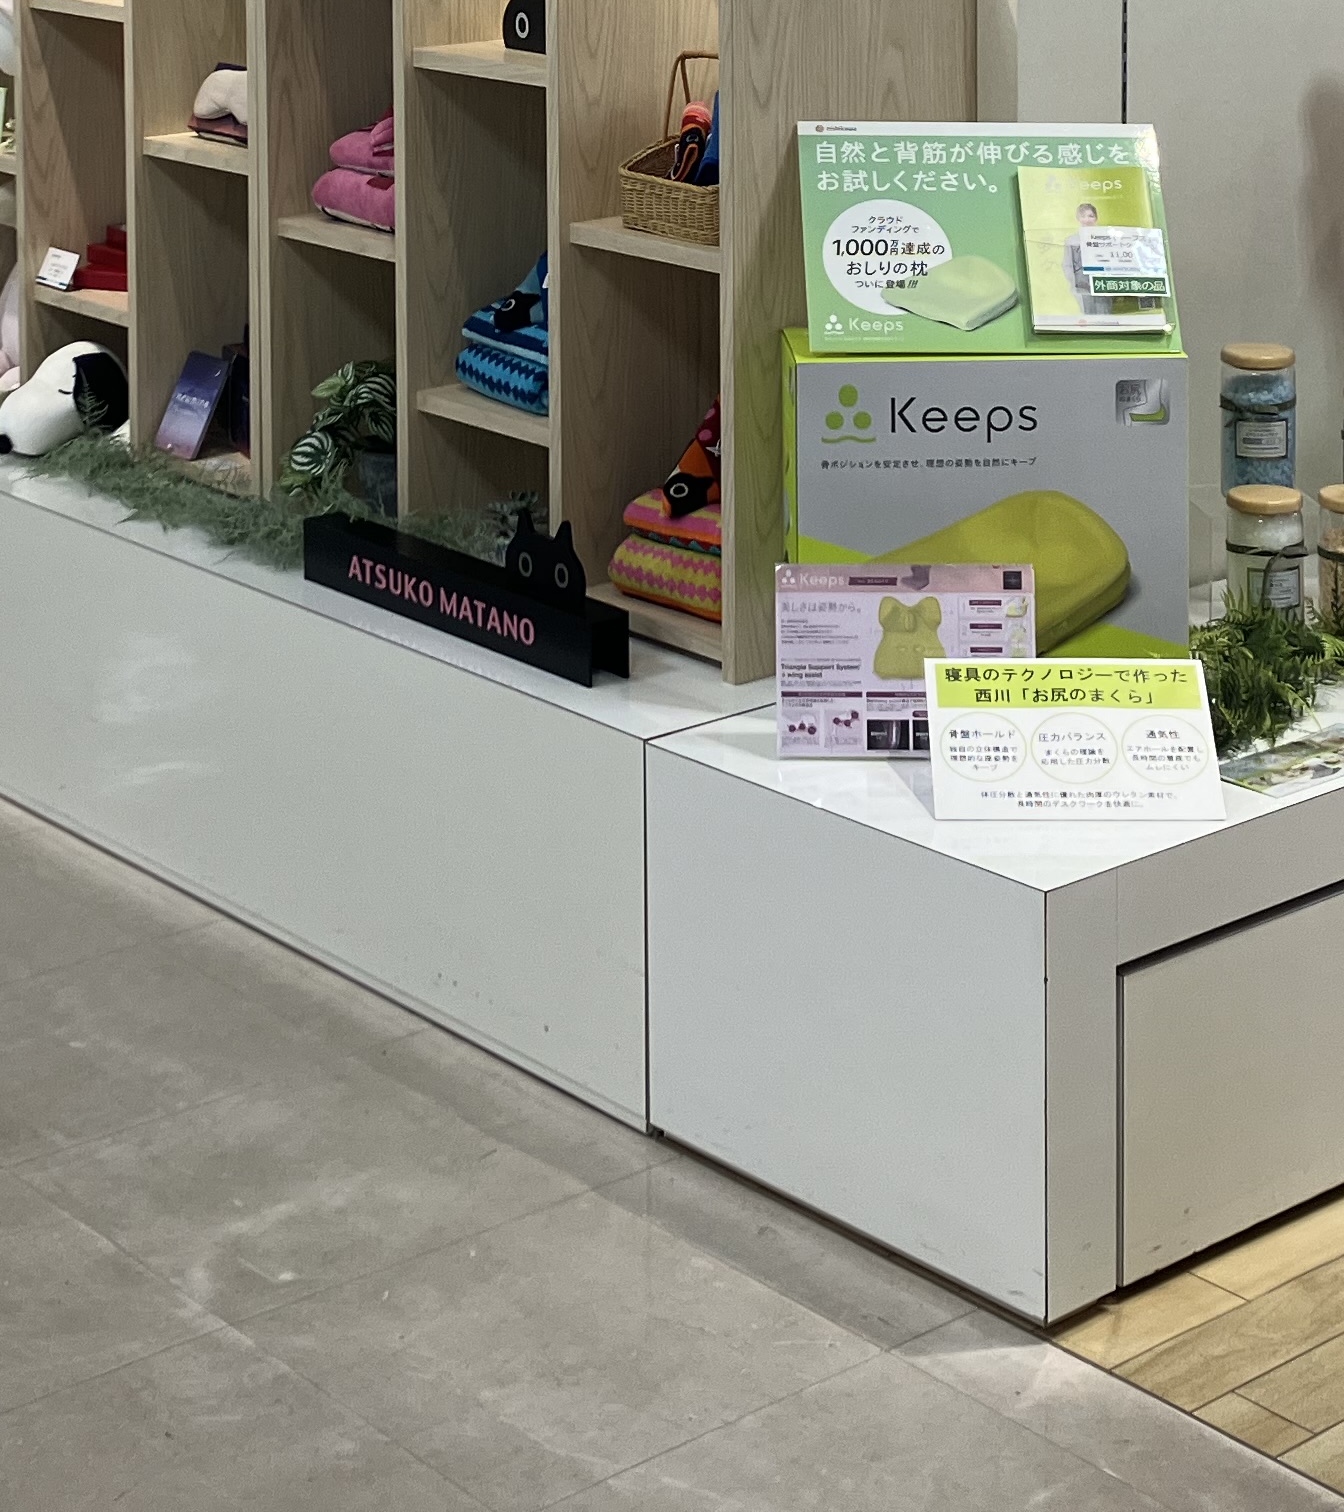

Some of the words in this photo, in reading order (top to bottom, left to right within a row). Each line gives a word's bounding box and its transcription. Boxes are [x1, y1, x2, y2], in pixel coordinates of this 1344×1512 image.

[815, 141, 1130, 165] 自然と背筋が伸びる感じを
[817, 169, 997, 193] お試しください。
[868, 216, 904, 224] クラウド
[851, 224, 920, 234] ファンディングで
[832, 238, 945, 257] 1,000万円達成の
[846, 261, 929, 277] おしりの枕
[1094, 279, 1165, 292] 外商対象の品
[849, 317, 904, 334] Keeps
[890, 396, 1038, 443] Keeps
[799, 572, 845, 587] Keeps
[348, 554, 434, 609] ATSUKO
[439, 587, 536, 646] MATANO
[945, 667, 1189, 683] 寝具のテクノロジーで作った
[974, 688, 1154, 704] 西川「お尻のまくら」
[1038, 732, 1107, 743] 圧力バランス
[1145, 729, 1181, 739] 通気性
